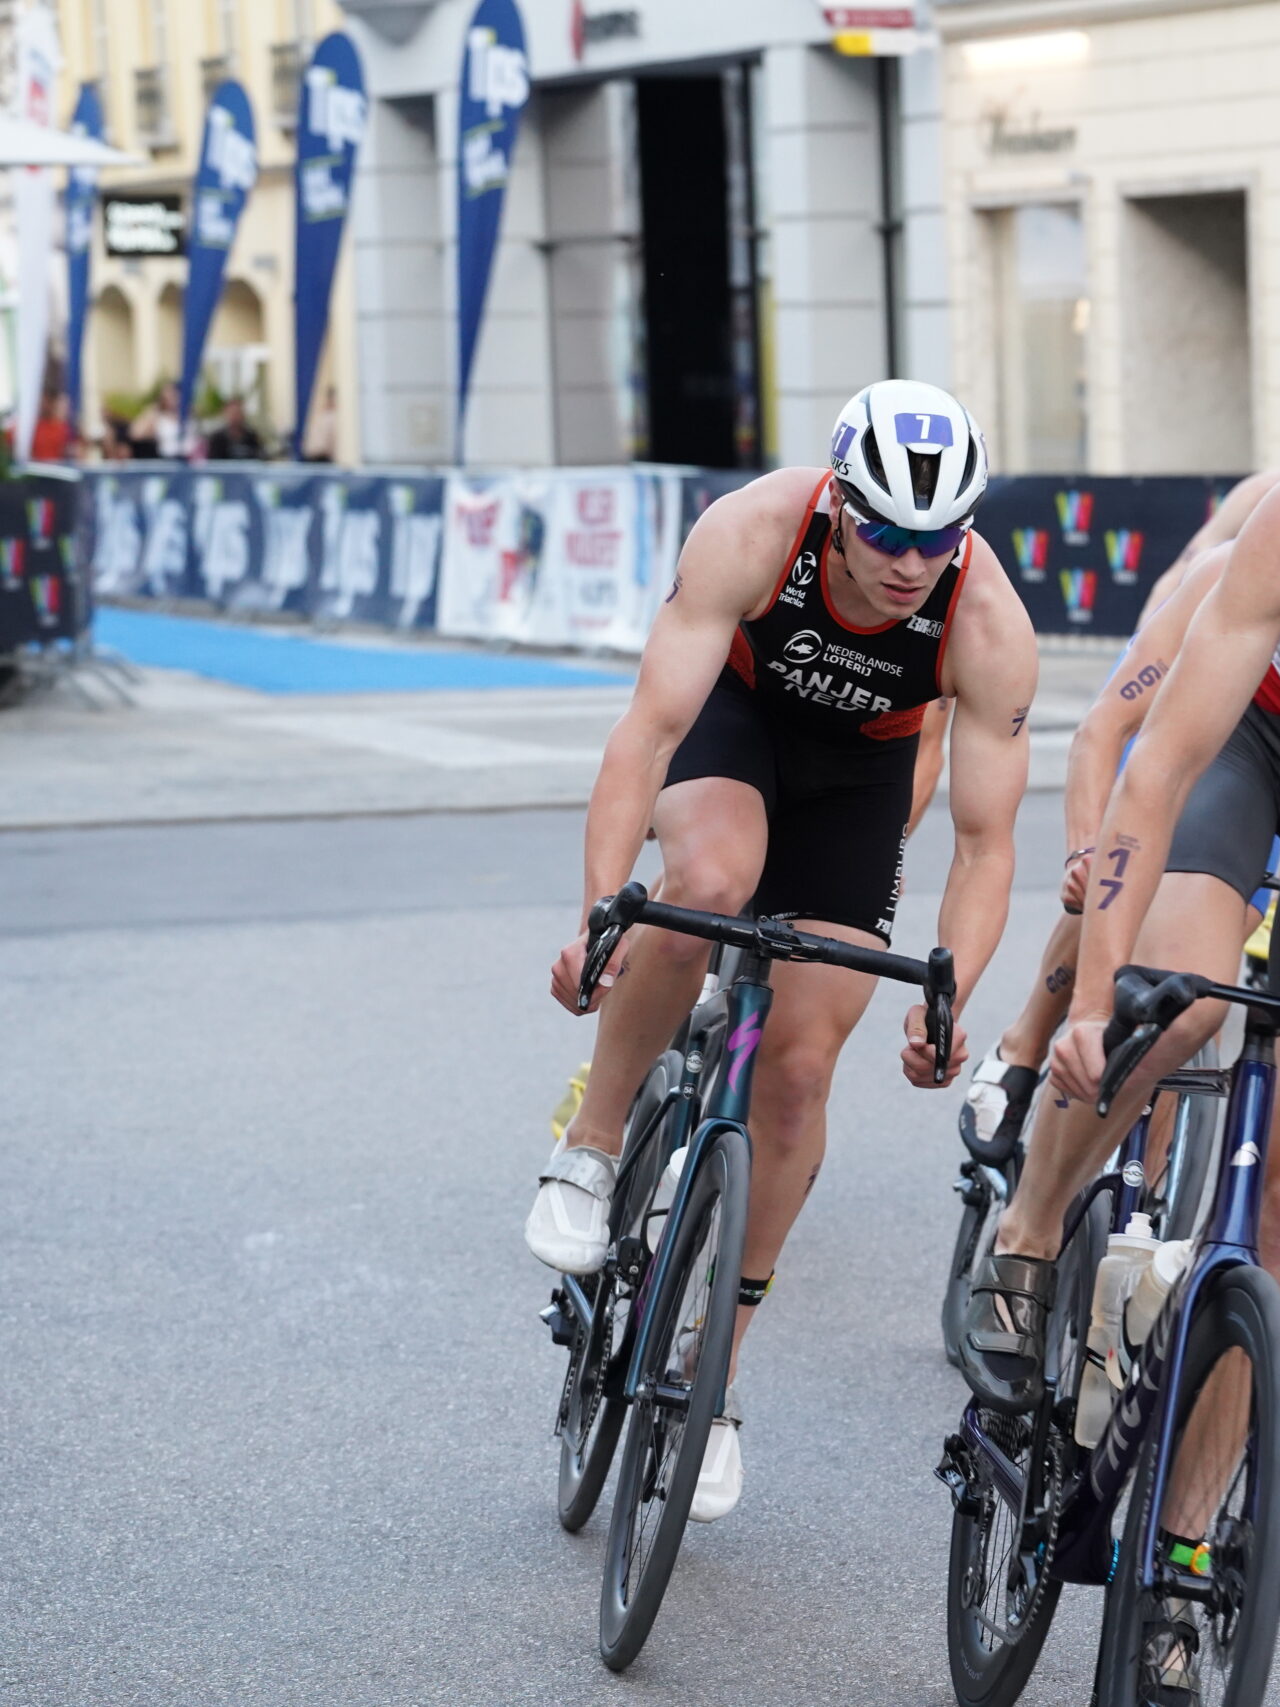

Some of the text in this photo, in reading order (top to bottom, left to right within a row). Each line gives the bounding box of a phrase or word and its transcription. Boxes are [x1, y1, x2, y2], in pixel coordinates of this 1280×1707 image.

[915, 415, 931, 440] 7
[785, 585, 806, 599] World
[822, 652, 872, 677] LOTERIJ
[826, 643, 904, 677] NEDERLANDSE
[766, 660, 893, 713] PANJER
[1012, 715, 1026, 737] 7
